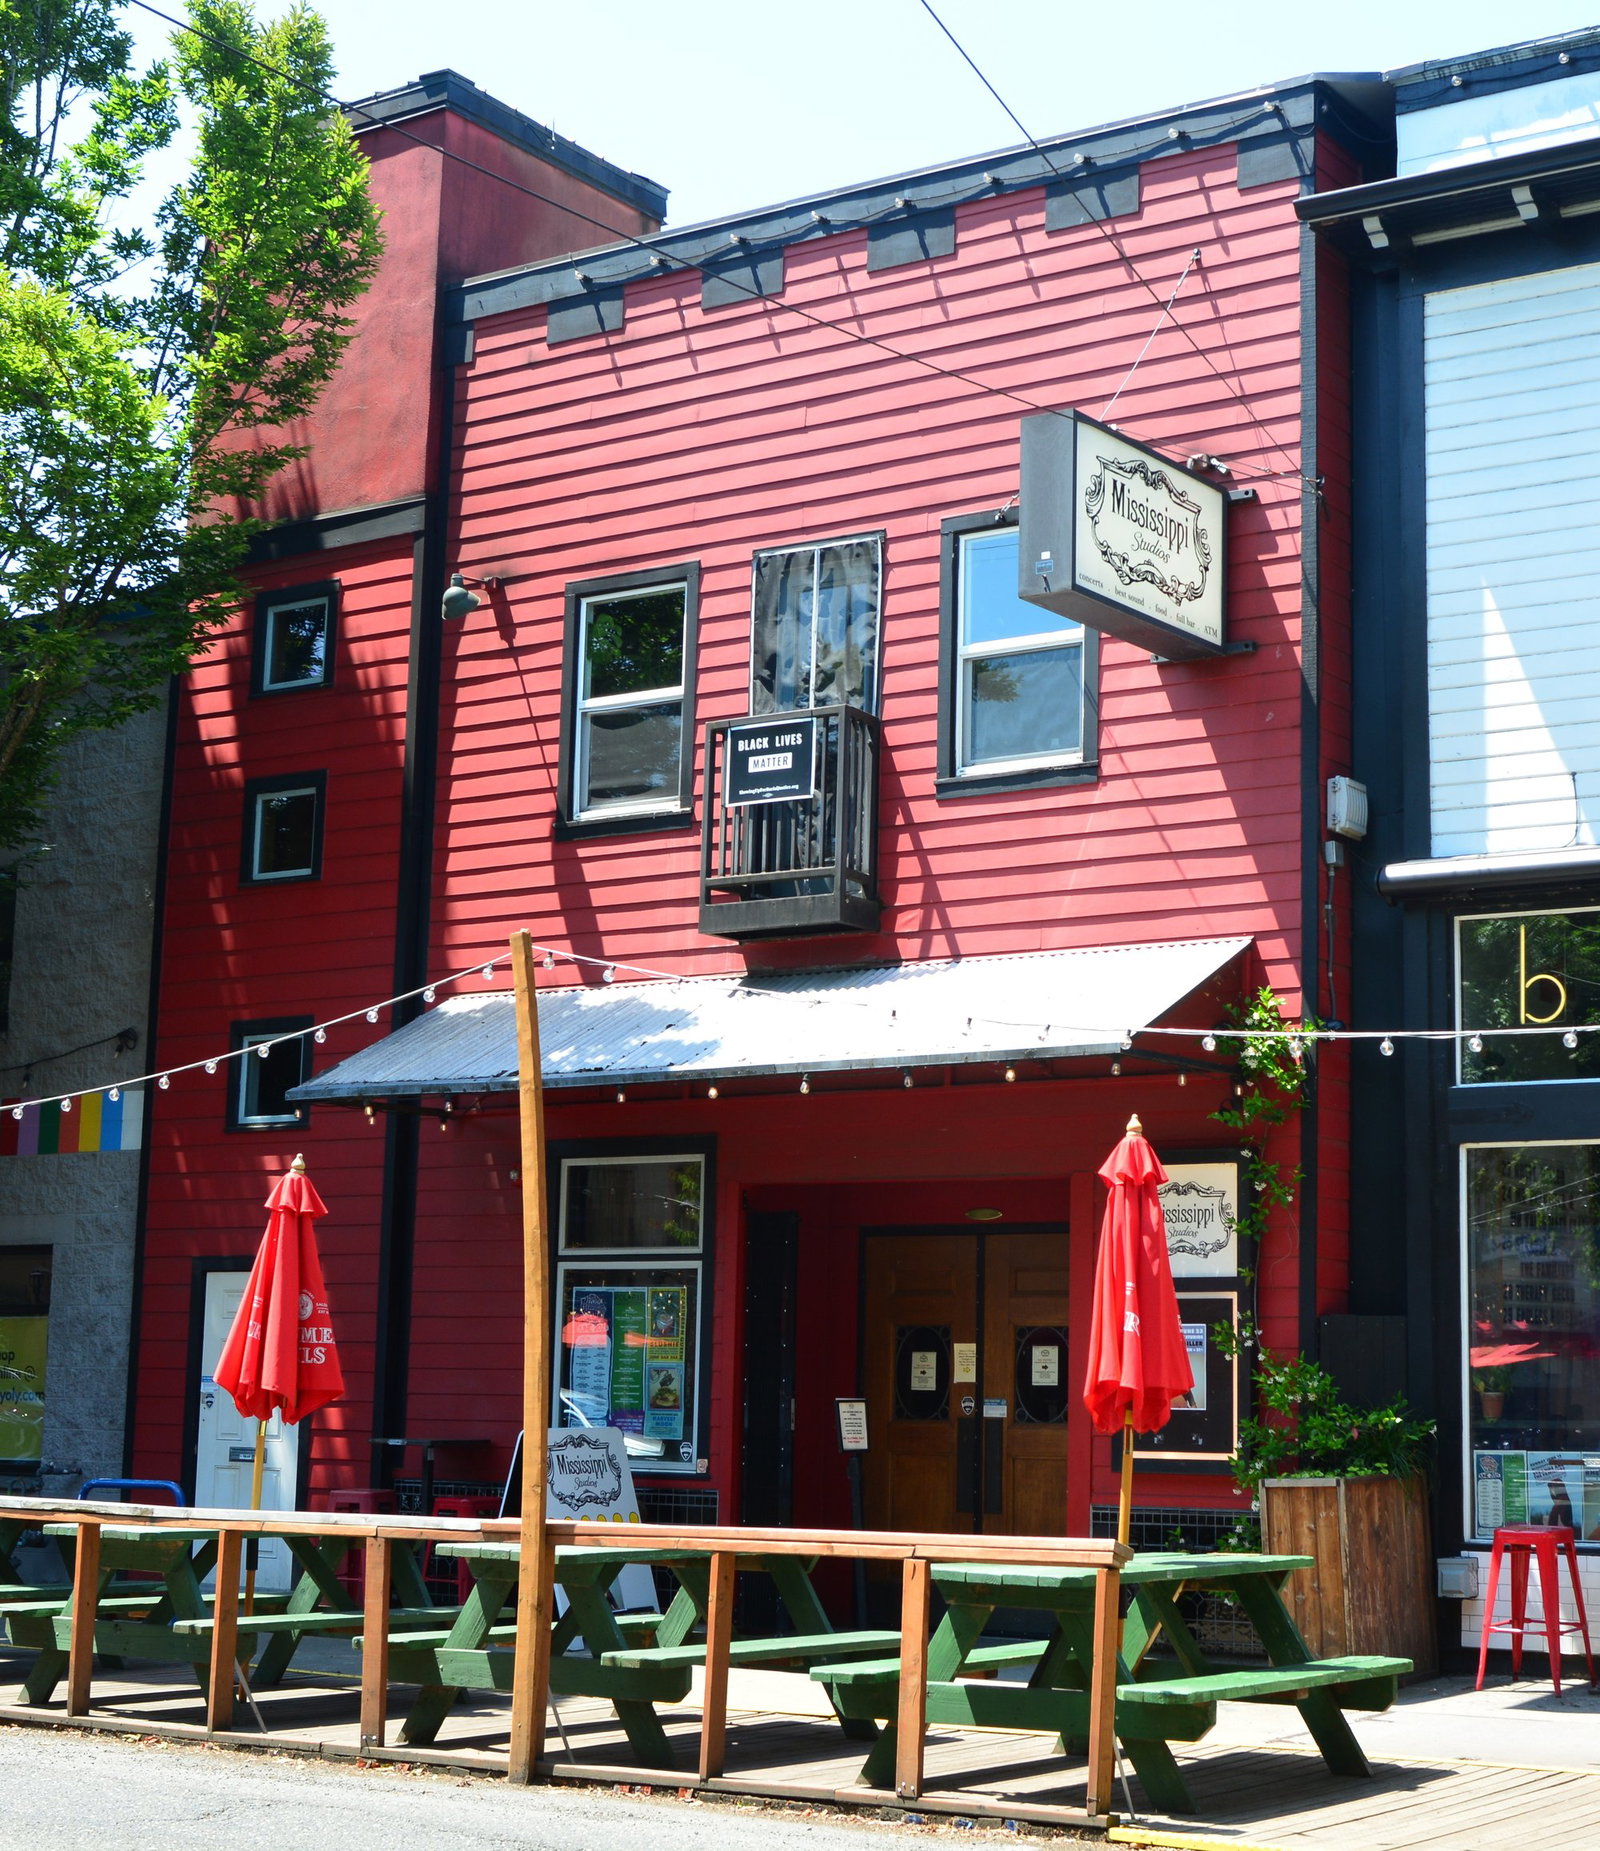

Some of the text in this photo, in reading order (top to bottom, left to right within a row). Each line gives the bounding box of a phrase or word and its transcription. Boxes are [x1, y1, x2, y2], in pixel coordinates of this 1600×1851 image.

[1112, 478, 1188, 554] Mississippi
[1131, 531, 1170, 563] Studios
[1079, 572, 1218, 638] concerts best sound food full bar ATM
[738, 733, 802, 752] BLACK LIVES
[753, 756, 788, 768] MATTER
[1520, 924, 1566, 1024] b
[1162, 1203, 1214, 1228] ississippi
[1166, 1225, 1199, 1239] Studios
[556, 1454, 608, 1479] Mississippi
[574, 1476, 598, 1490] Studios
